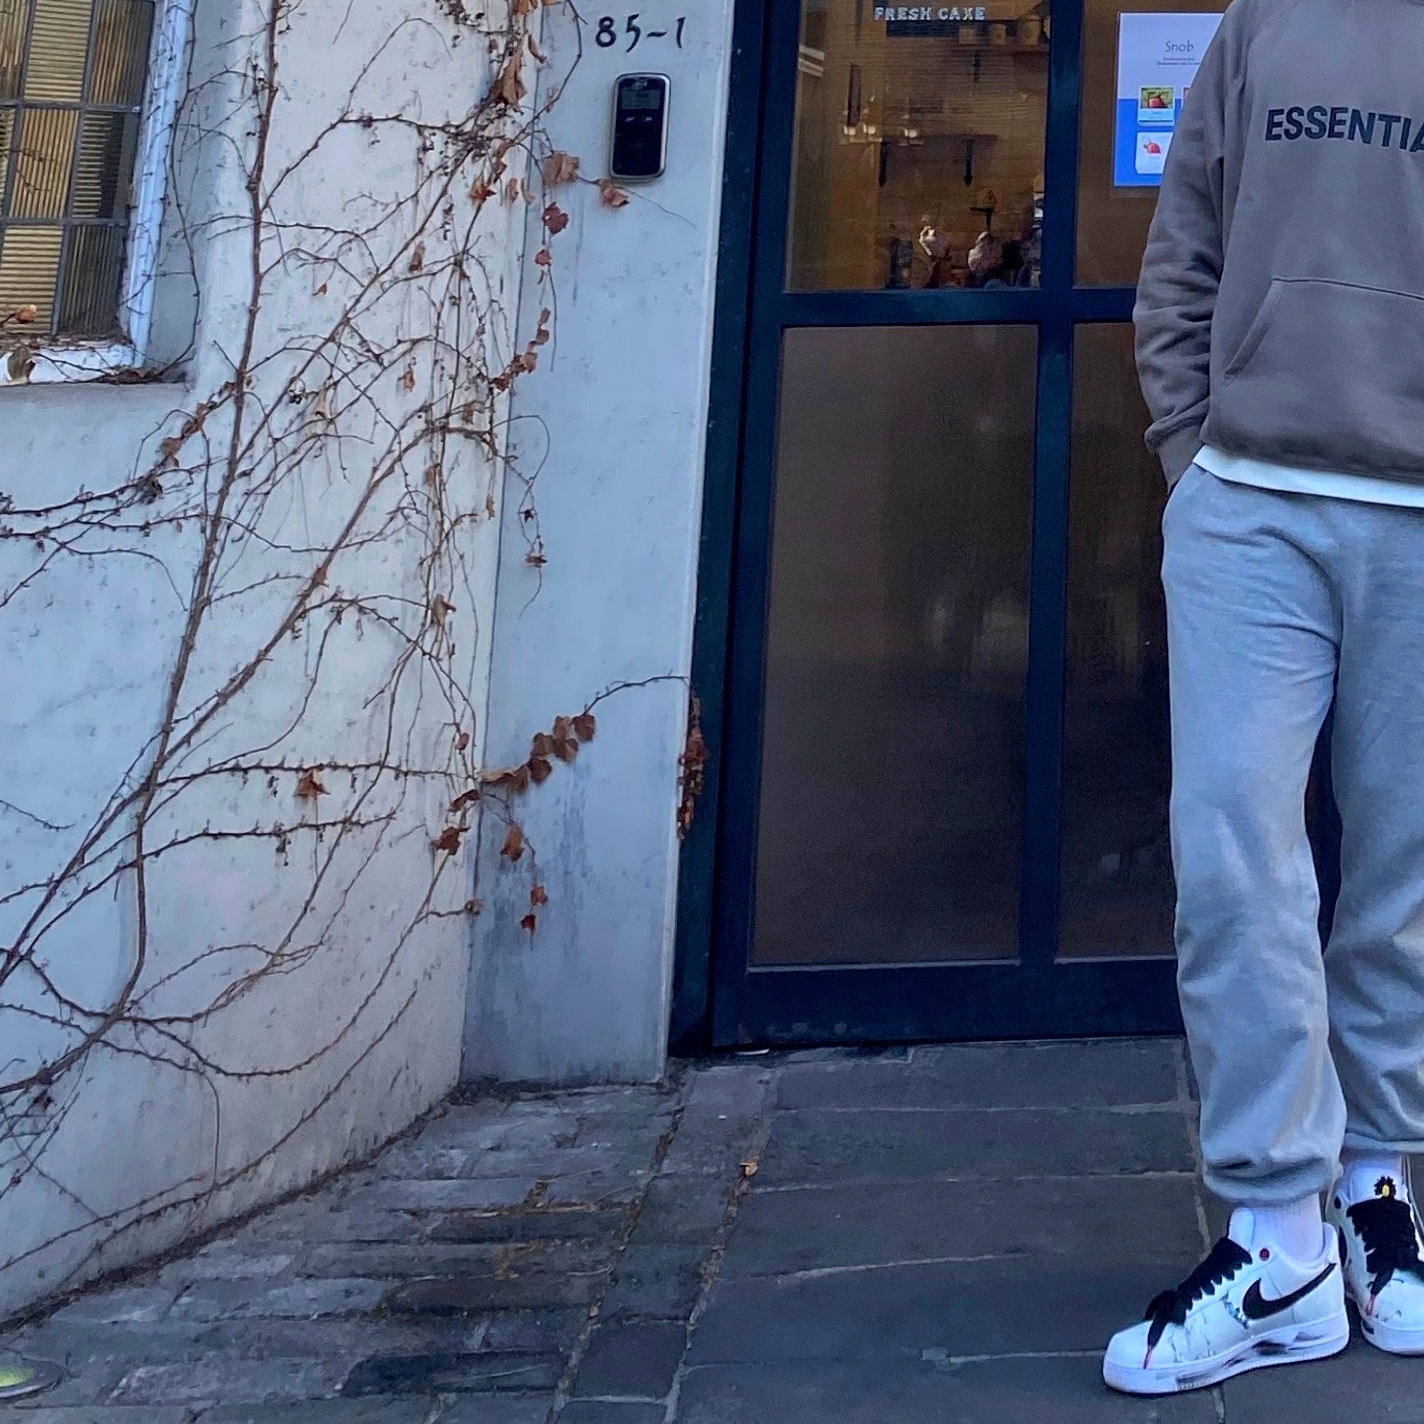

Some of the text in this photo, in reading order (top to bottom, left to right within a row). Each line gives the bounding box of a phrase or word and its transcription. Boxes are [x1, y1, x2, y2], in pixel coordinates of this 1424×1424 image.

[874, 7, 985, 21] FRESH CAKE
[595, 14, 686, 53] 85-1
[1165, 39, 1195, 53] Snob
